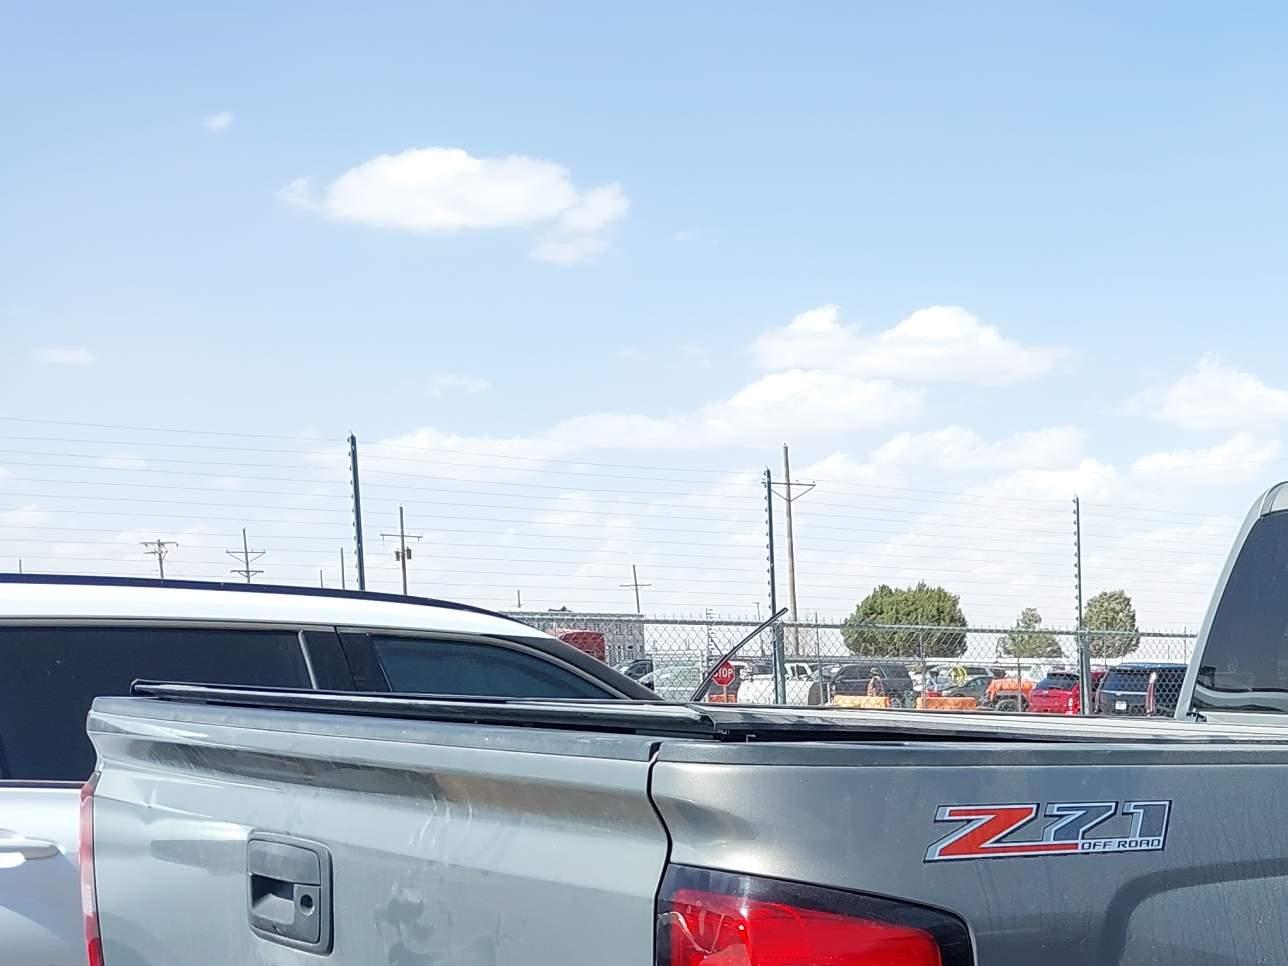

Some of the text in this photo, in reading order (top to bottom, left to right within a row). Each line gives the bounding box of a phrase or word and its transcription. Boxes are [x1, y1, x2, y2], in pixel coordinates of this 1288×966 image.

[923, 800, 1172, 863] Z71
[1081, 838, 1161, 851] OFF ROAD
